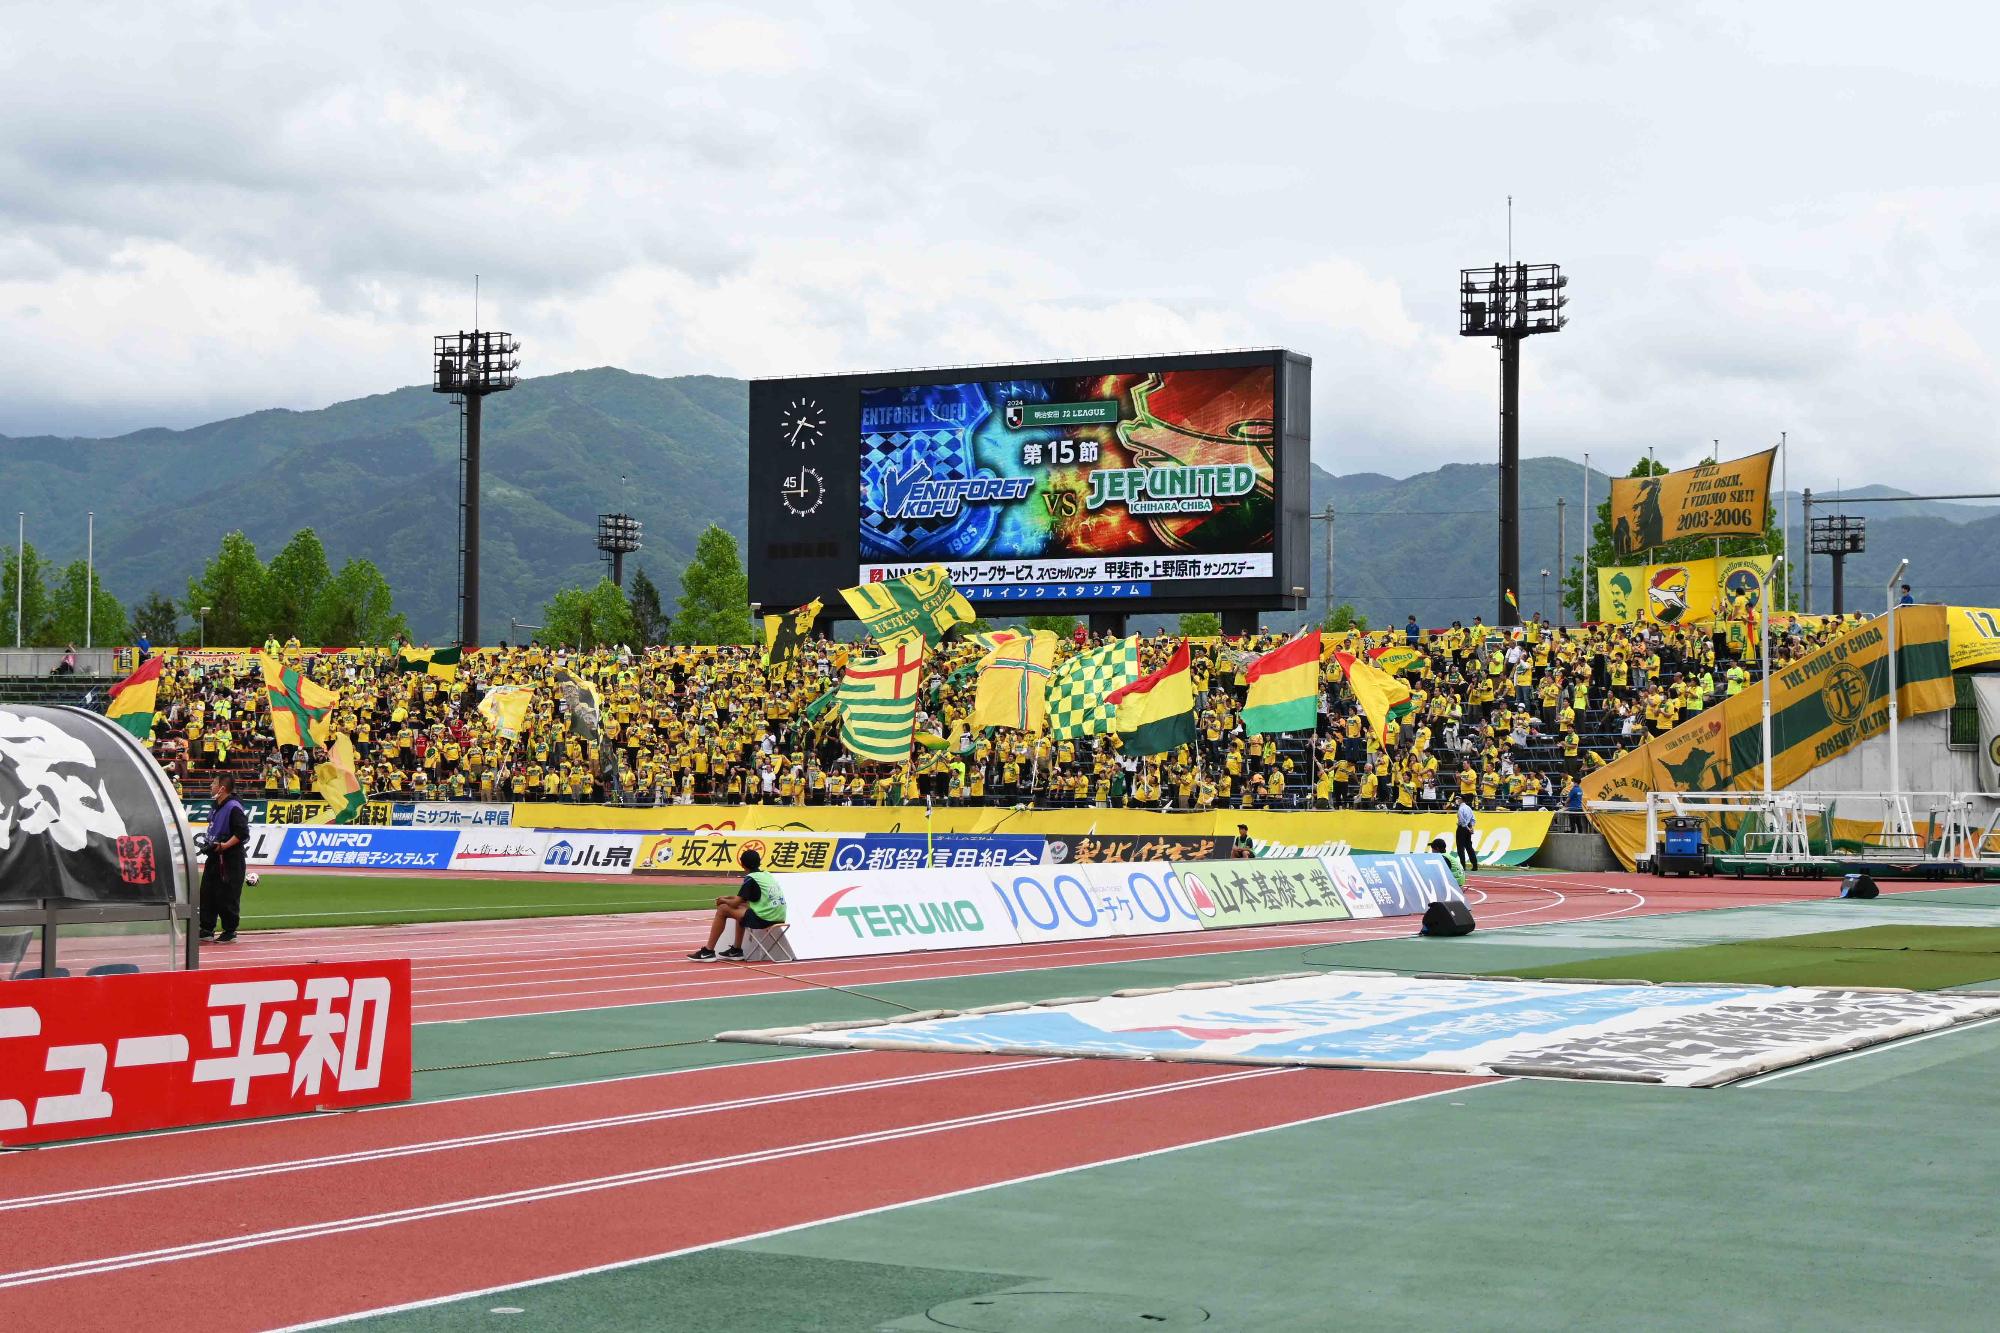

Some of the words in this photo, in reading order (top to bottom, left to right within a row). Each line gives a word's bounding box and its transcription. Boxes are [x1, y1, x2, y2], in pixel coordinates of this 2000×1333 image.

[1062, 410, 1071, 418] J2
[1072, 408, 1106, 417] LEAGUE
[784, 477, 797, 488] 45
[884, 462, 1035, 518] VENTFORET
[1087, 469, 1146, 509] JEF
[1146, 465, 1255, 498] UNITED
[902, 499, 960, 518] KOFU
[1042, 492, 1077, 517] VS
[1130, 501, 1178, 514] ICHIHARA
[1180, 500, 1212, 512] CHIBA
[1676, 508, 1752, 531] 2003-2006
[1036, 566, 1097, 580] スペシャルマッチ
[1104, 559, 1201, 579] 甲斐市・上野原市
[1204, 561, 1255, 575] サンクスデー
[1781, 668, 1805, 690] THE
[1802, 651, 1835, 680] PRIDE
[1834, 642, 1849, 661] OF
[1848, 627, 1883, 654] CHIBA
[317, 833, 372, 846] NIPRO
[572, 844, 634, 867] 小泉
[677, 839, 736, 867] 坂本
[1210, 869, 1341, 914] 山本基礎工業
[835, 900, 984, 938] TERUMO
